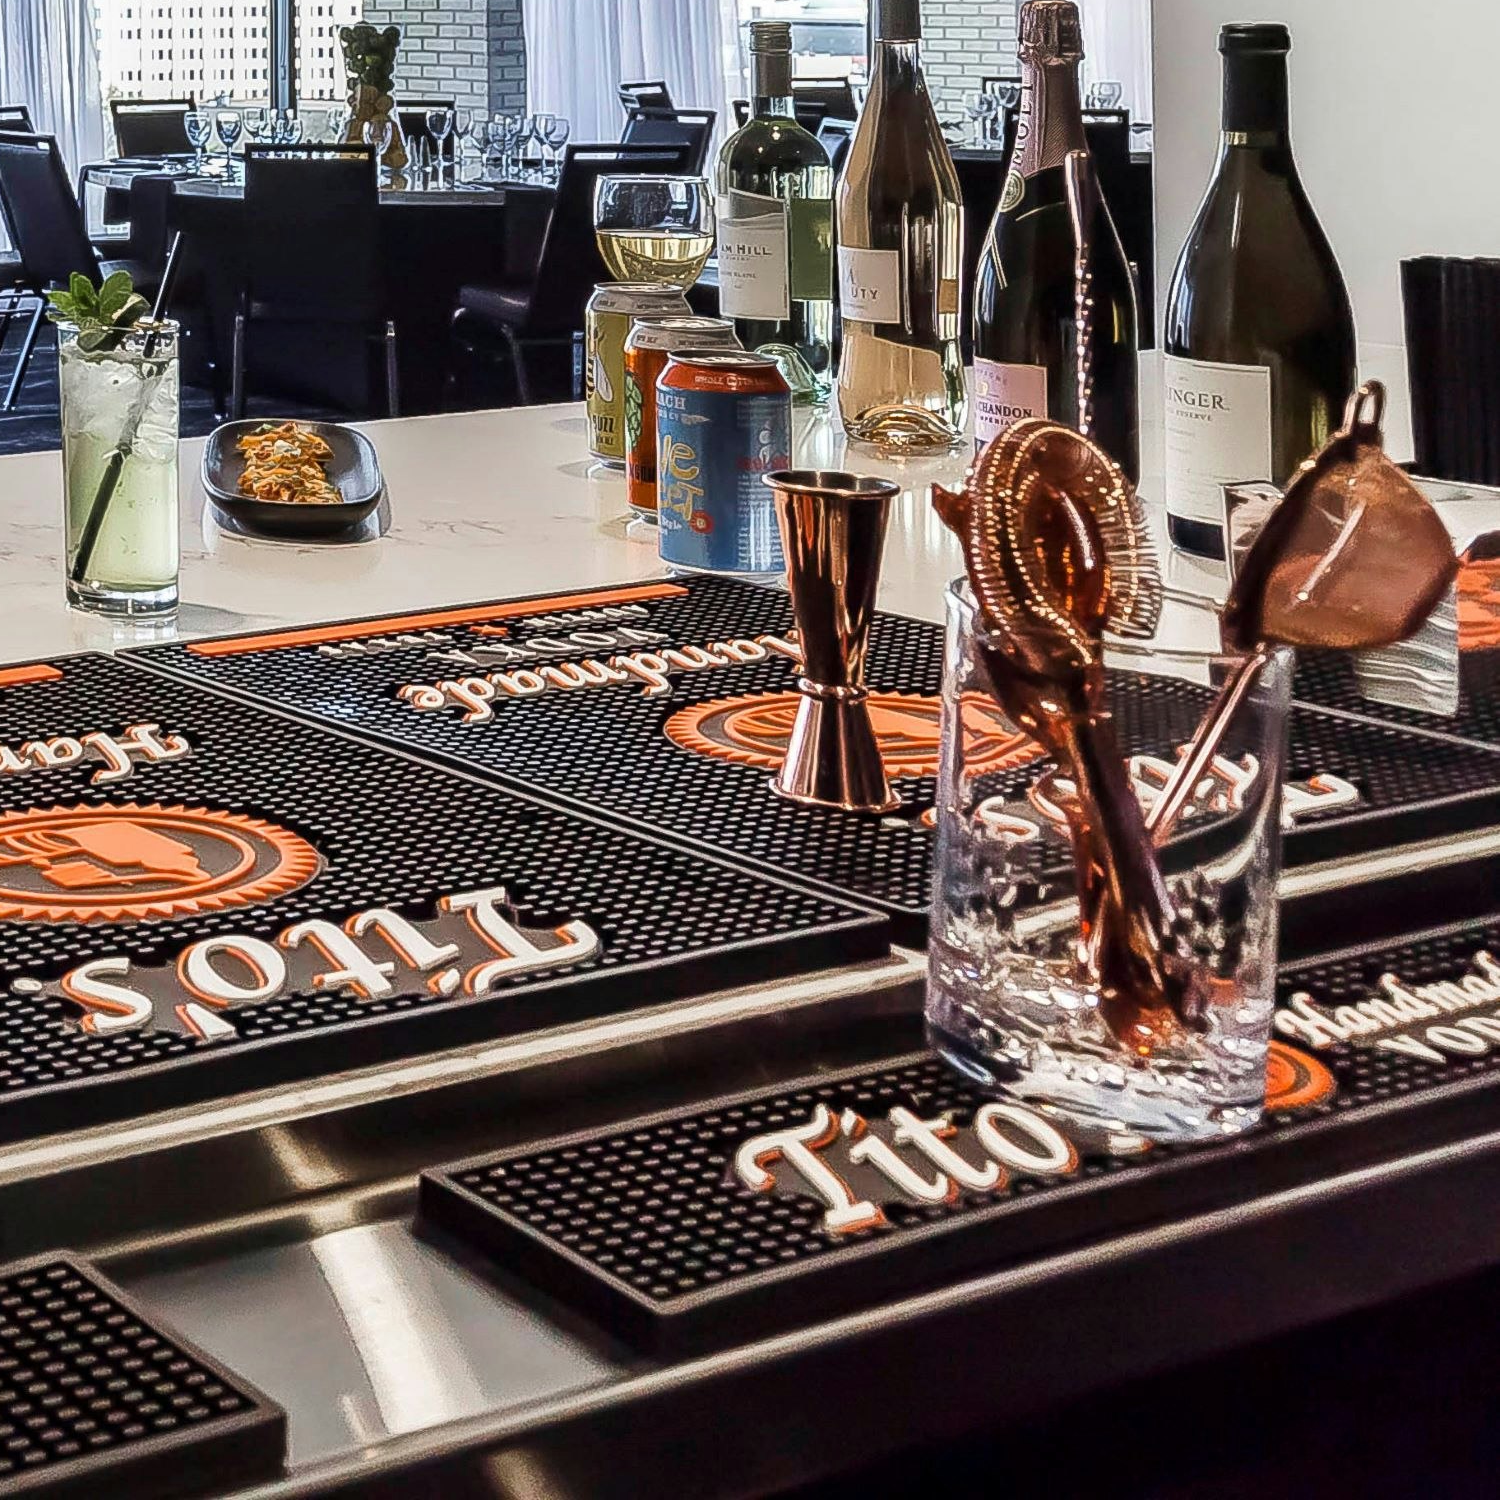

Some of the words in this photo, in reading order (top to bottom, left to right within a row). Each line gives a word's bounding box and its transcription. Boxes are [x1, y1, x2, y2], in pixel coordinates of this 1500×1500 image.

[736, 243, 772, 256] HILL
[426, 627, 669, 667] VODKA
[62, 885, 598, 1038] Tito's
[1376, 1013, 1500, 1064] VOD
[733, 1102, 1080, 1235] Tito
